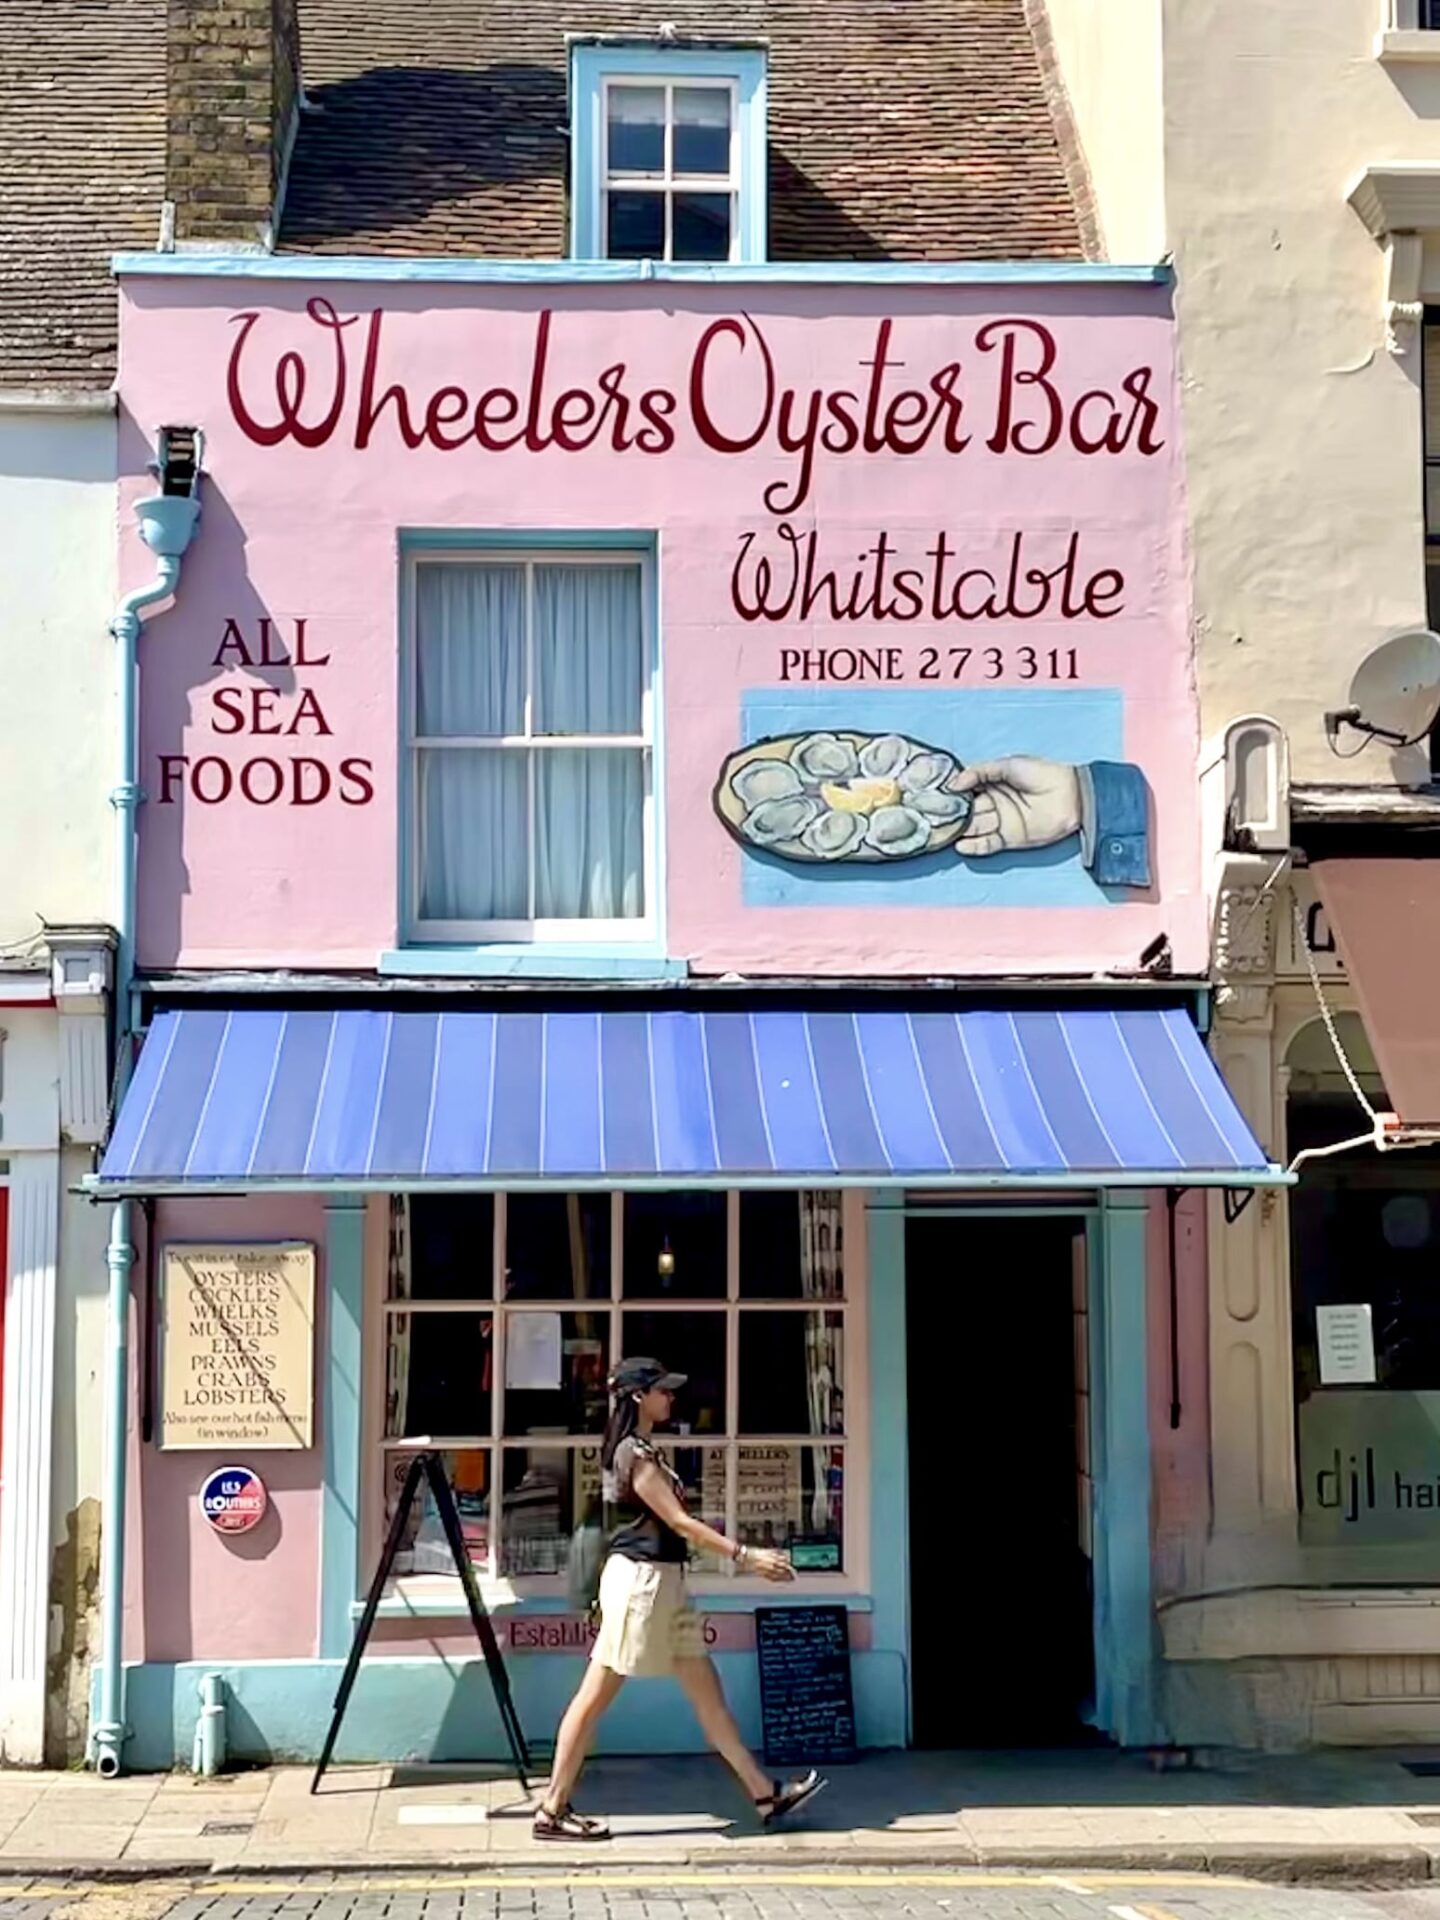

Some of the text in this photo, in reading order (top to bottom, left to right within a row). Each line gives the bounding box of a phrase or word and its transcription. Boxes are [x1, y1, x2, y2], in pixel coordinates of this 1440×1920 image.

[227, 296, 1165, 515] Wheelers Oyster Bar
[731, 522, 1125, 621] Whitstable
[211, 617, 331, 667] ALL
[780, 646, 1079, 681] PHONE 273311
[210, 687, 333, 737] SEA
[156, 753, 375, 806] FOODS
[193, 1270, 279, 1287] OYSTERS
[188, 1287, 281, 1303] COCKLES
[194, 1304, 278, 1320] WHELKS
[188, 1321, 280, 1337] MUSSELS
[211, 1338, 261, 1354] EELS
[190, 1354, 278, 1371] PRAWNS
[197, 1371, 271, 1387] CRABS
[183, 1388, 288, 1405] LOBSTERS
[1316, 1447, 1376, 1522] djl
